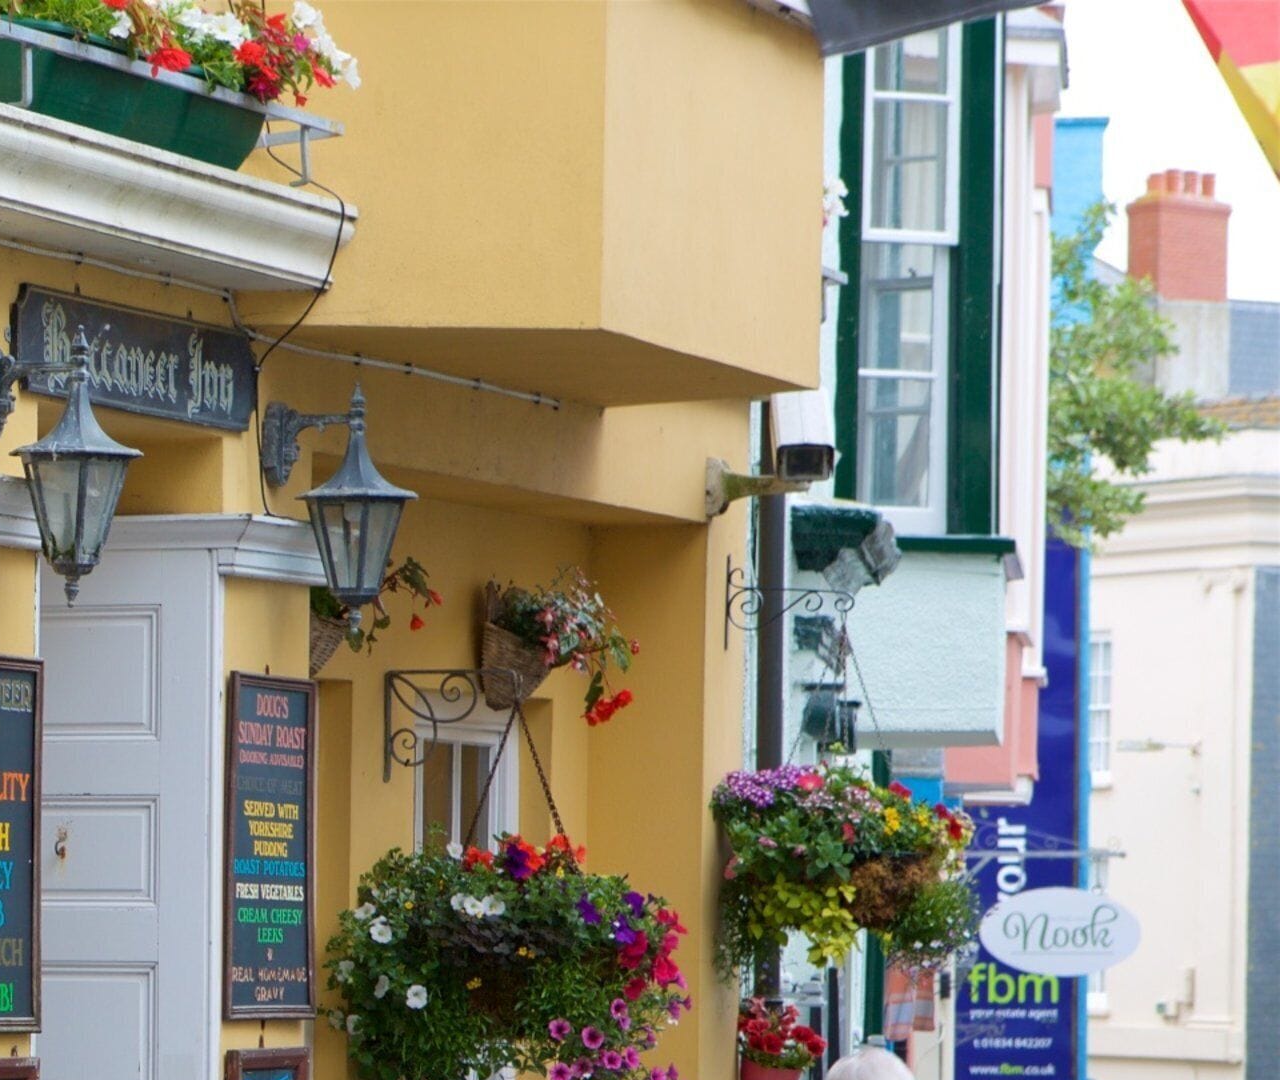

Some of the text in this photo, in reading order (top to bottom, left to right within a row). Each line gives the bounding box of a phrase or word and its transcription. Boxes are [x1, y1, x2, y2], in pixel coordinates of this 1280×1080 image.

[188, 328, 234, 421] Inn
[256, 693, 289, 719] DOUG'S
[238, 721, 306, 751] SUNDAY ROAST
[244, 800, 299, 820] SERVED WITH
[248, 820, 294, 840] YORKSHIRE
[234, 859, 305, 877] ROAST POTATOES
[997, 817, 1027, 902] our
[236, 883, 304, 902] FRESH VEGETABLES
[237, 908, 304, 925] CREAM CHEESY
[1003, 902, 1119, 951] Nook
[258, 928, 283, 944] LEEKS
[232, 966, 255, 982] REAL
[967, 962, 1059, 1004] fbm
[255, 986, 285, 1002] GRAVY
[1028, 1008, 1058, 1020] agent
